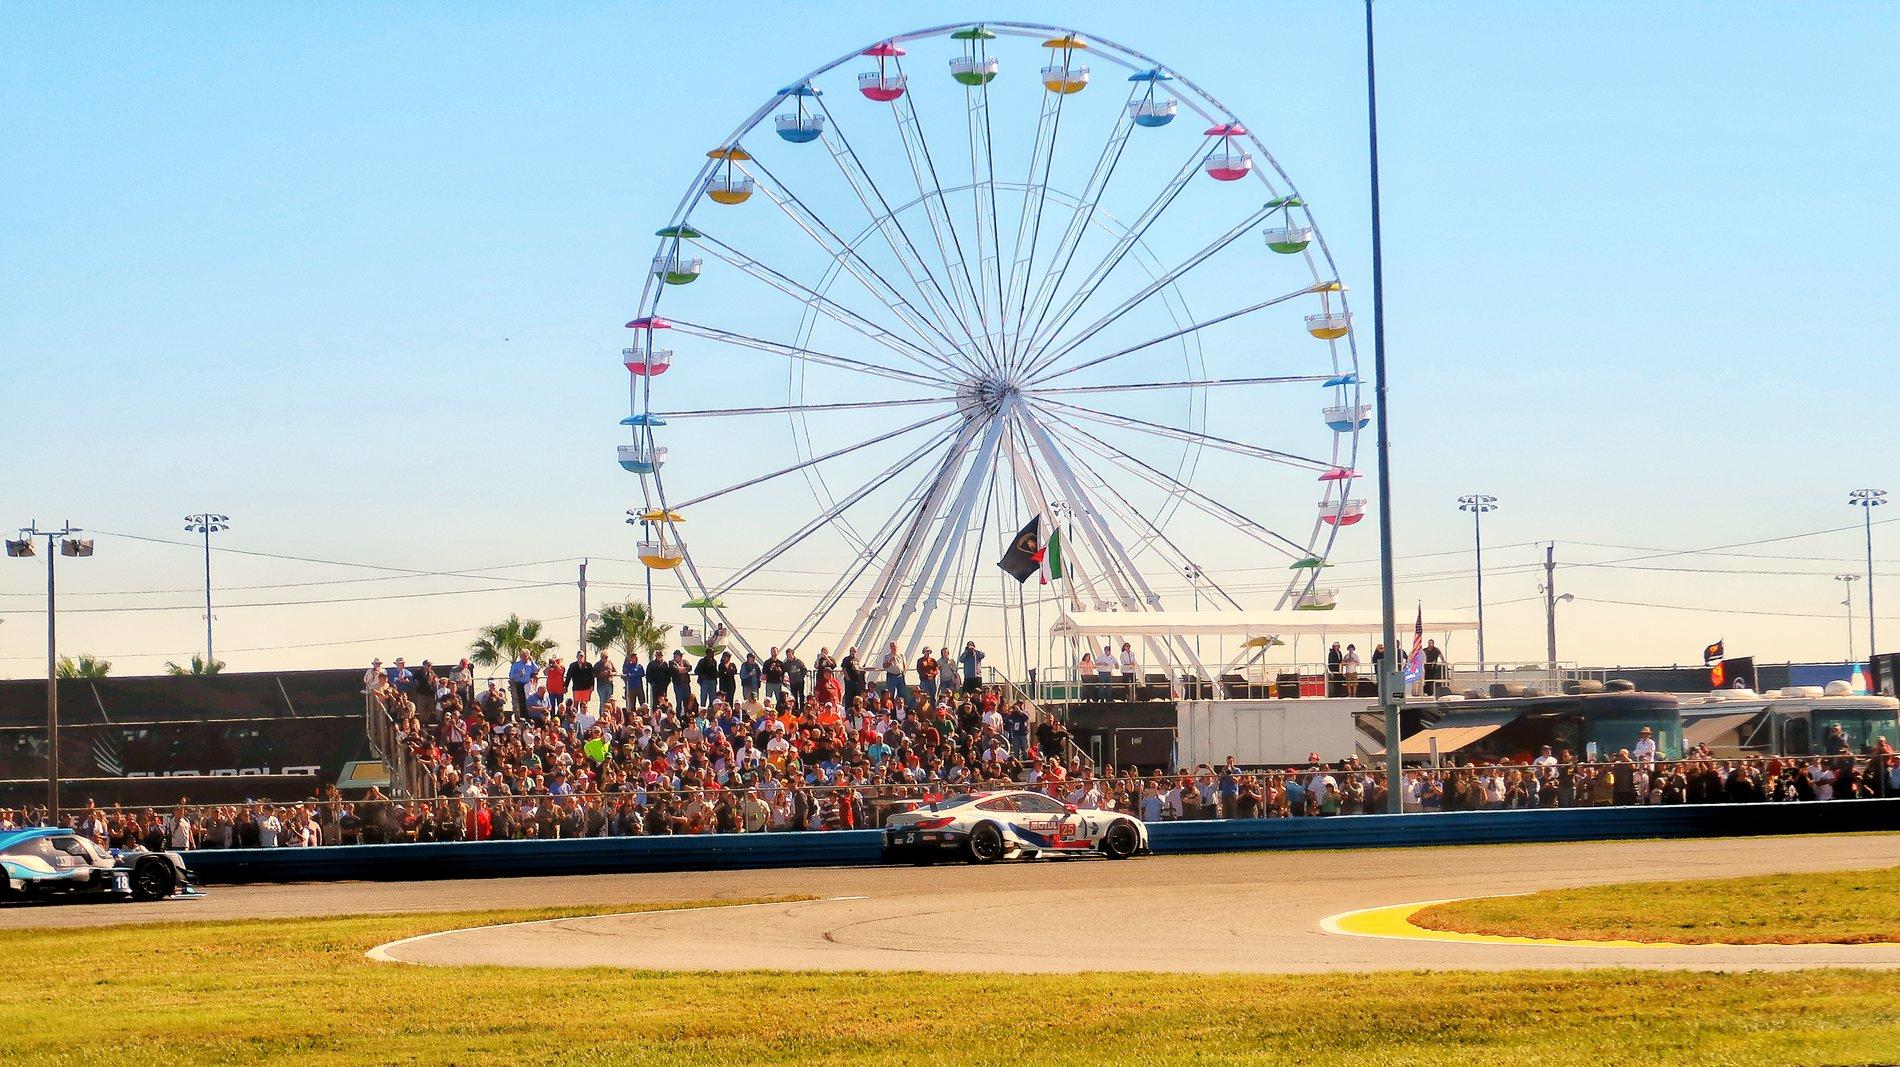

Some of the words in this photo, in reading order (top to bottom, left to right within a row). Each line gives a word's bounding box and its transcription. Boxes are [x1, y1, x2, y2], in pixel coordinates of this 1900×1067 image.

[1030, 821, 1058, 830] MOTUL
[1061, 824, 1074, 835] 25
[116, 876, 128, 889] 18
